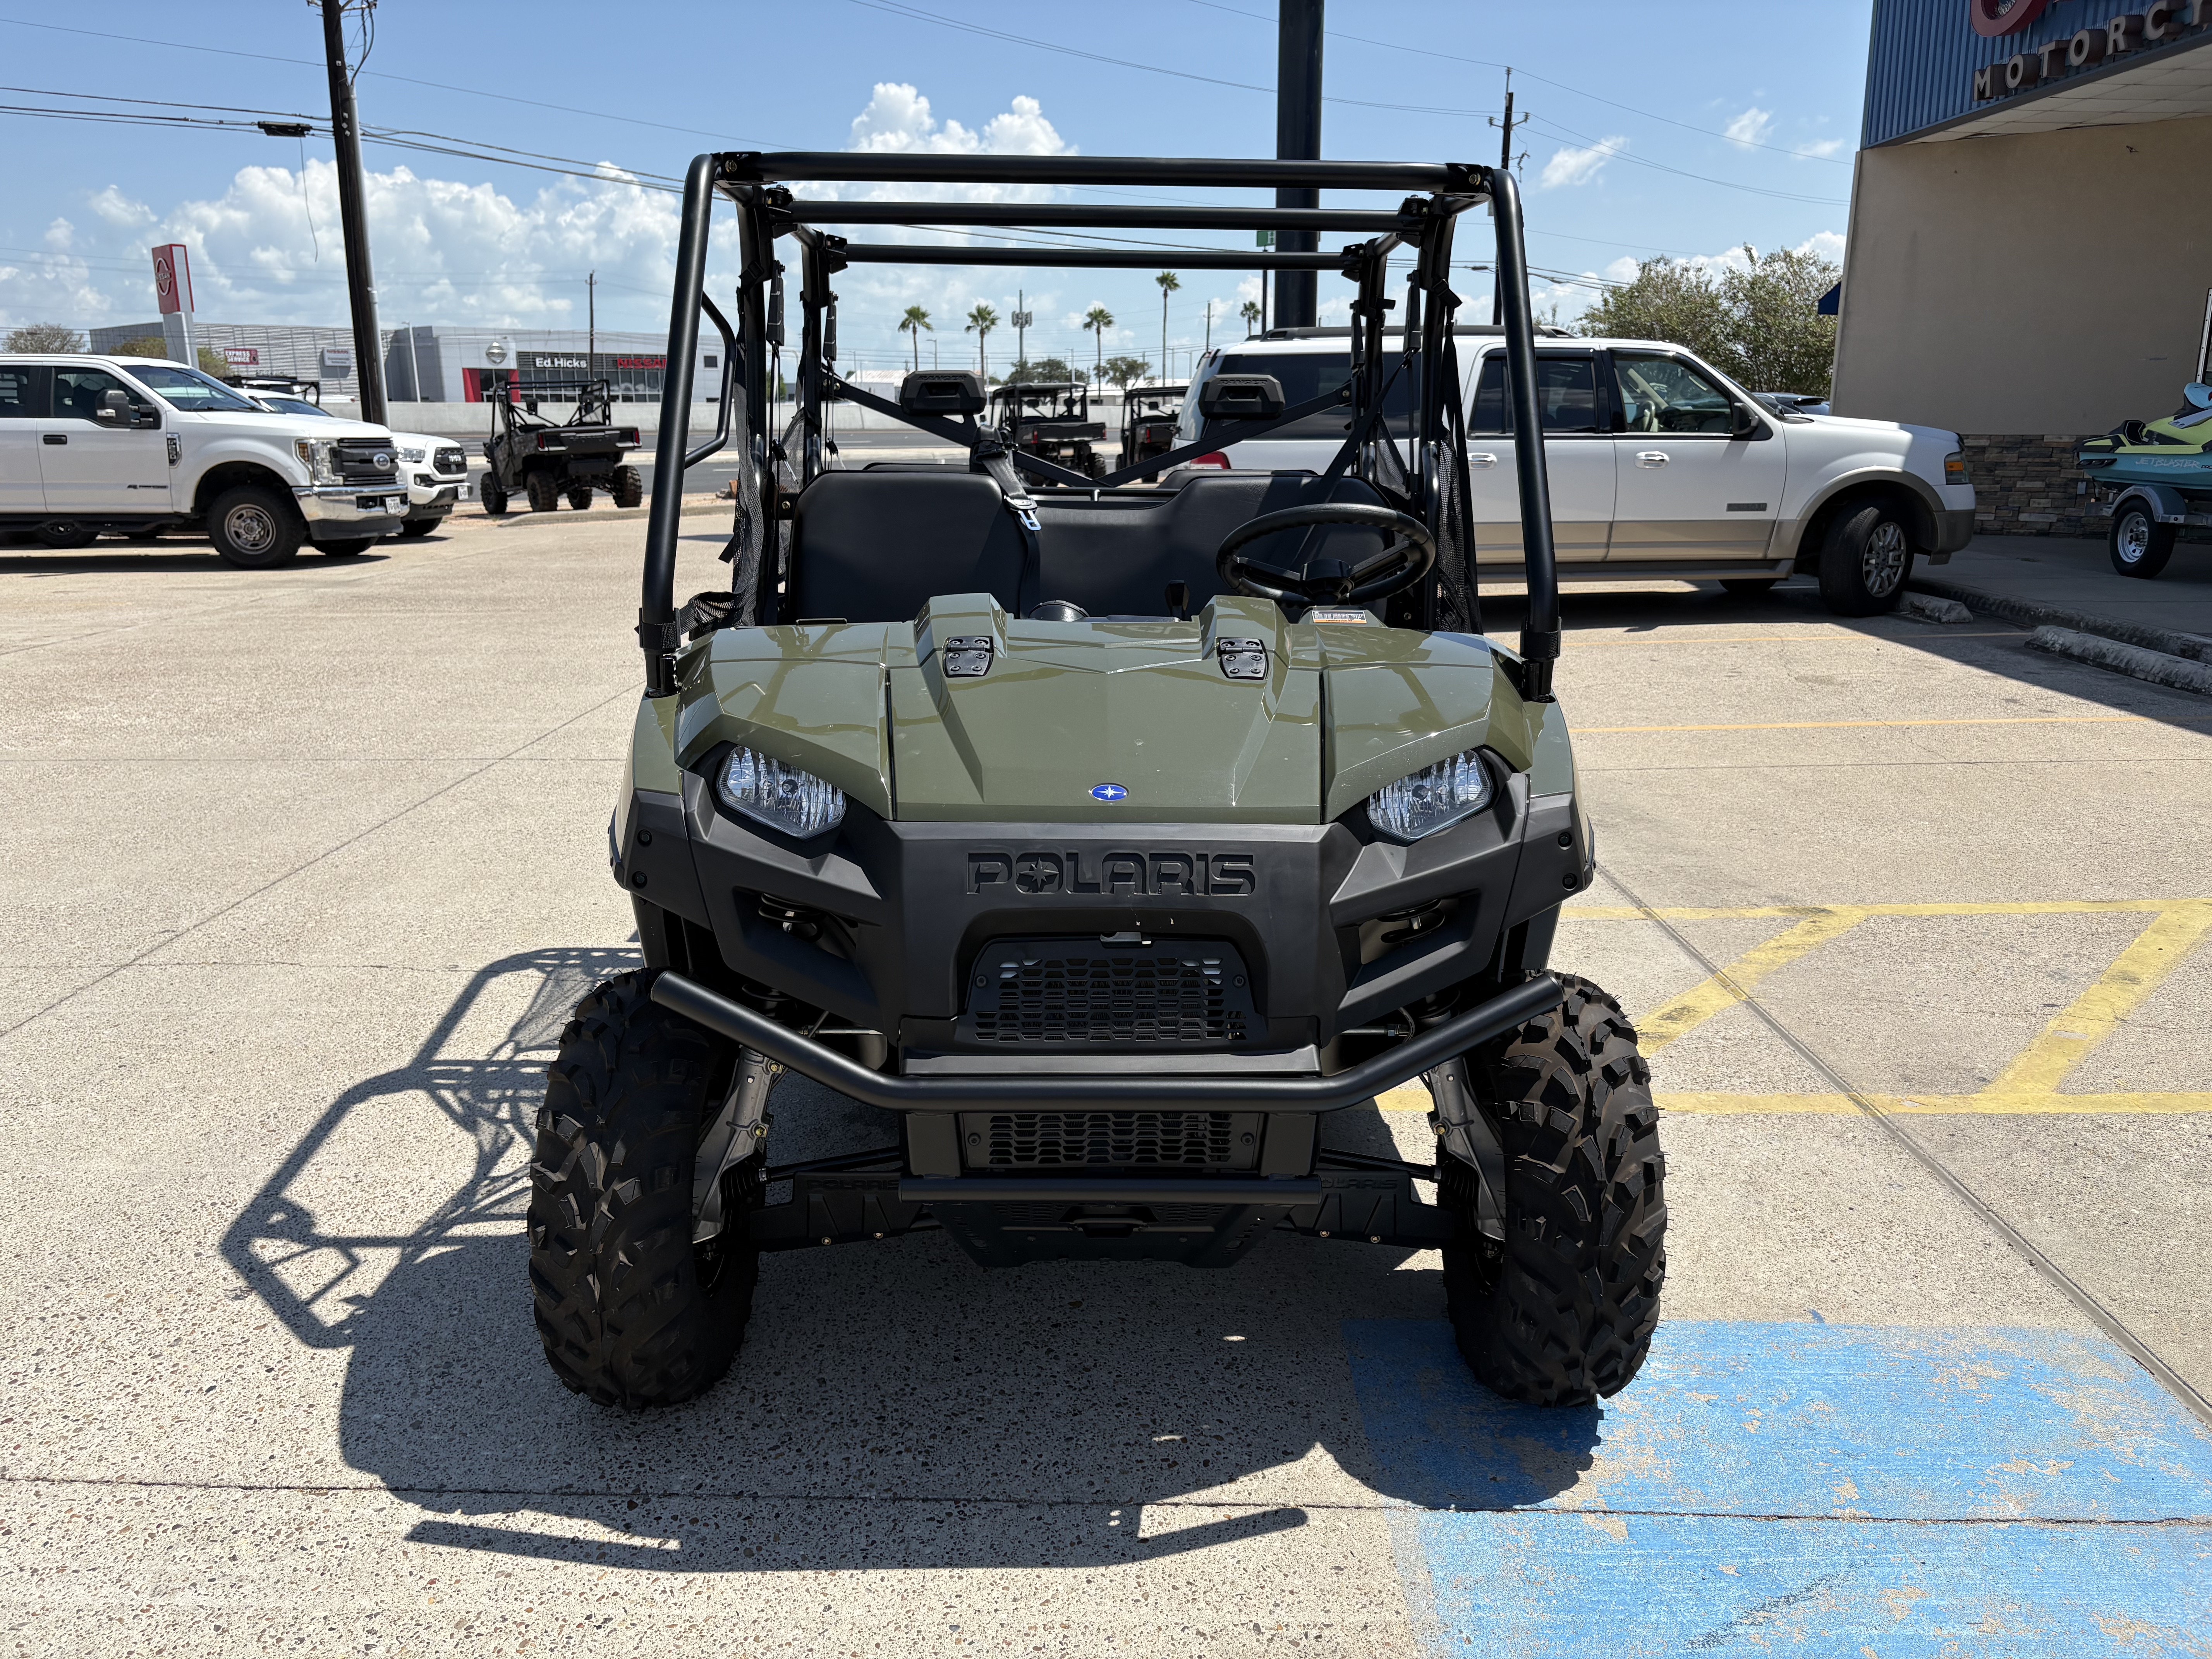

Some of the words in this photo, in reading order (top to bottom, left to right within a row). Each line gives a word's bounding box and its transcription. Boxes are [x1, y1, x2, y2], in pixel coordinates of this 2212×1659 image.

[536, 357, 551, 368] Ed
[555, 358, 587, 368] Hicks
[967, 852, 1255, 896] POLARIS
[1321, 1178, 1397, 1189] OLARIS
